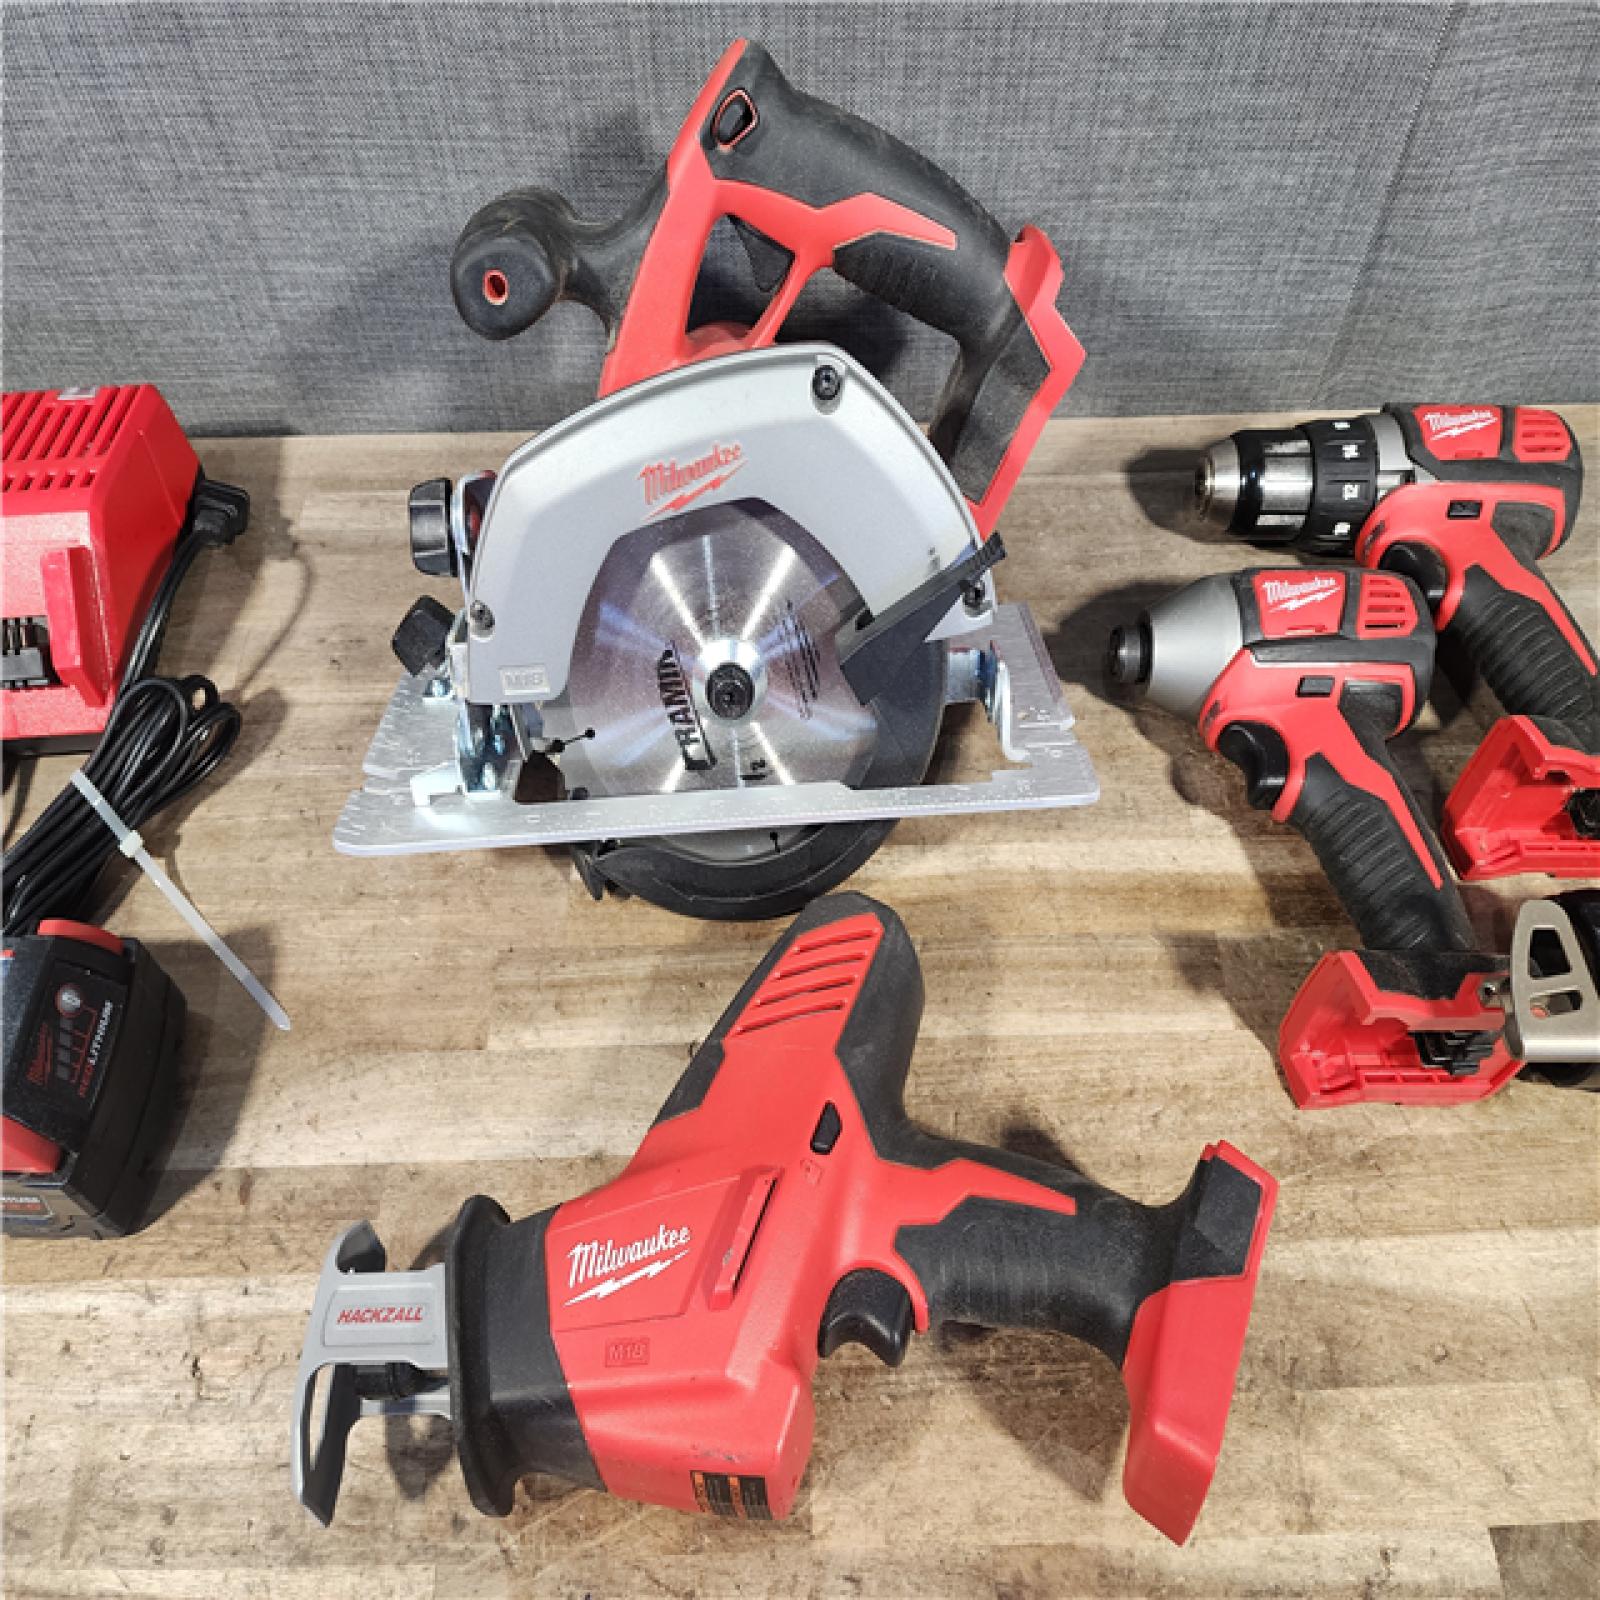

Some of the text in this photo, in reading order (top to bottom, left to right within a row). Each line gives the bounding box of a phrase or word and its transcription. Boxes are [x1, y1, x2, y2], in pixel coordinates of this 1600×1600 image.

[1423, 409, 1493, 432] Milwaukee
[637, 441, 742, 505] Milwaukee
[1262, 576, 1336, 604] Milwaukee
[567, 1224, 692, 1288] Milwaukee
[336, 1306, 424, 1324] HACKZALL
